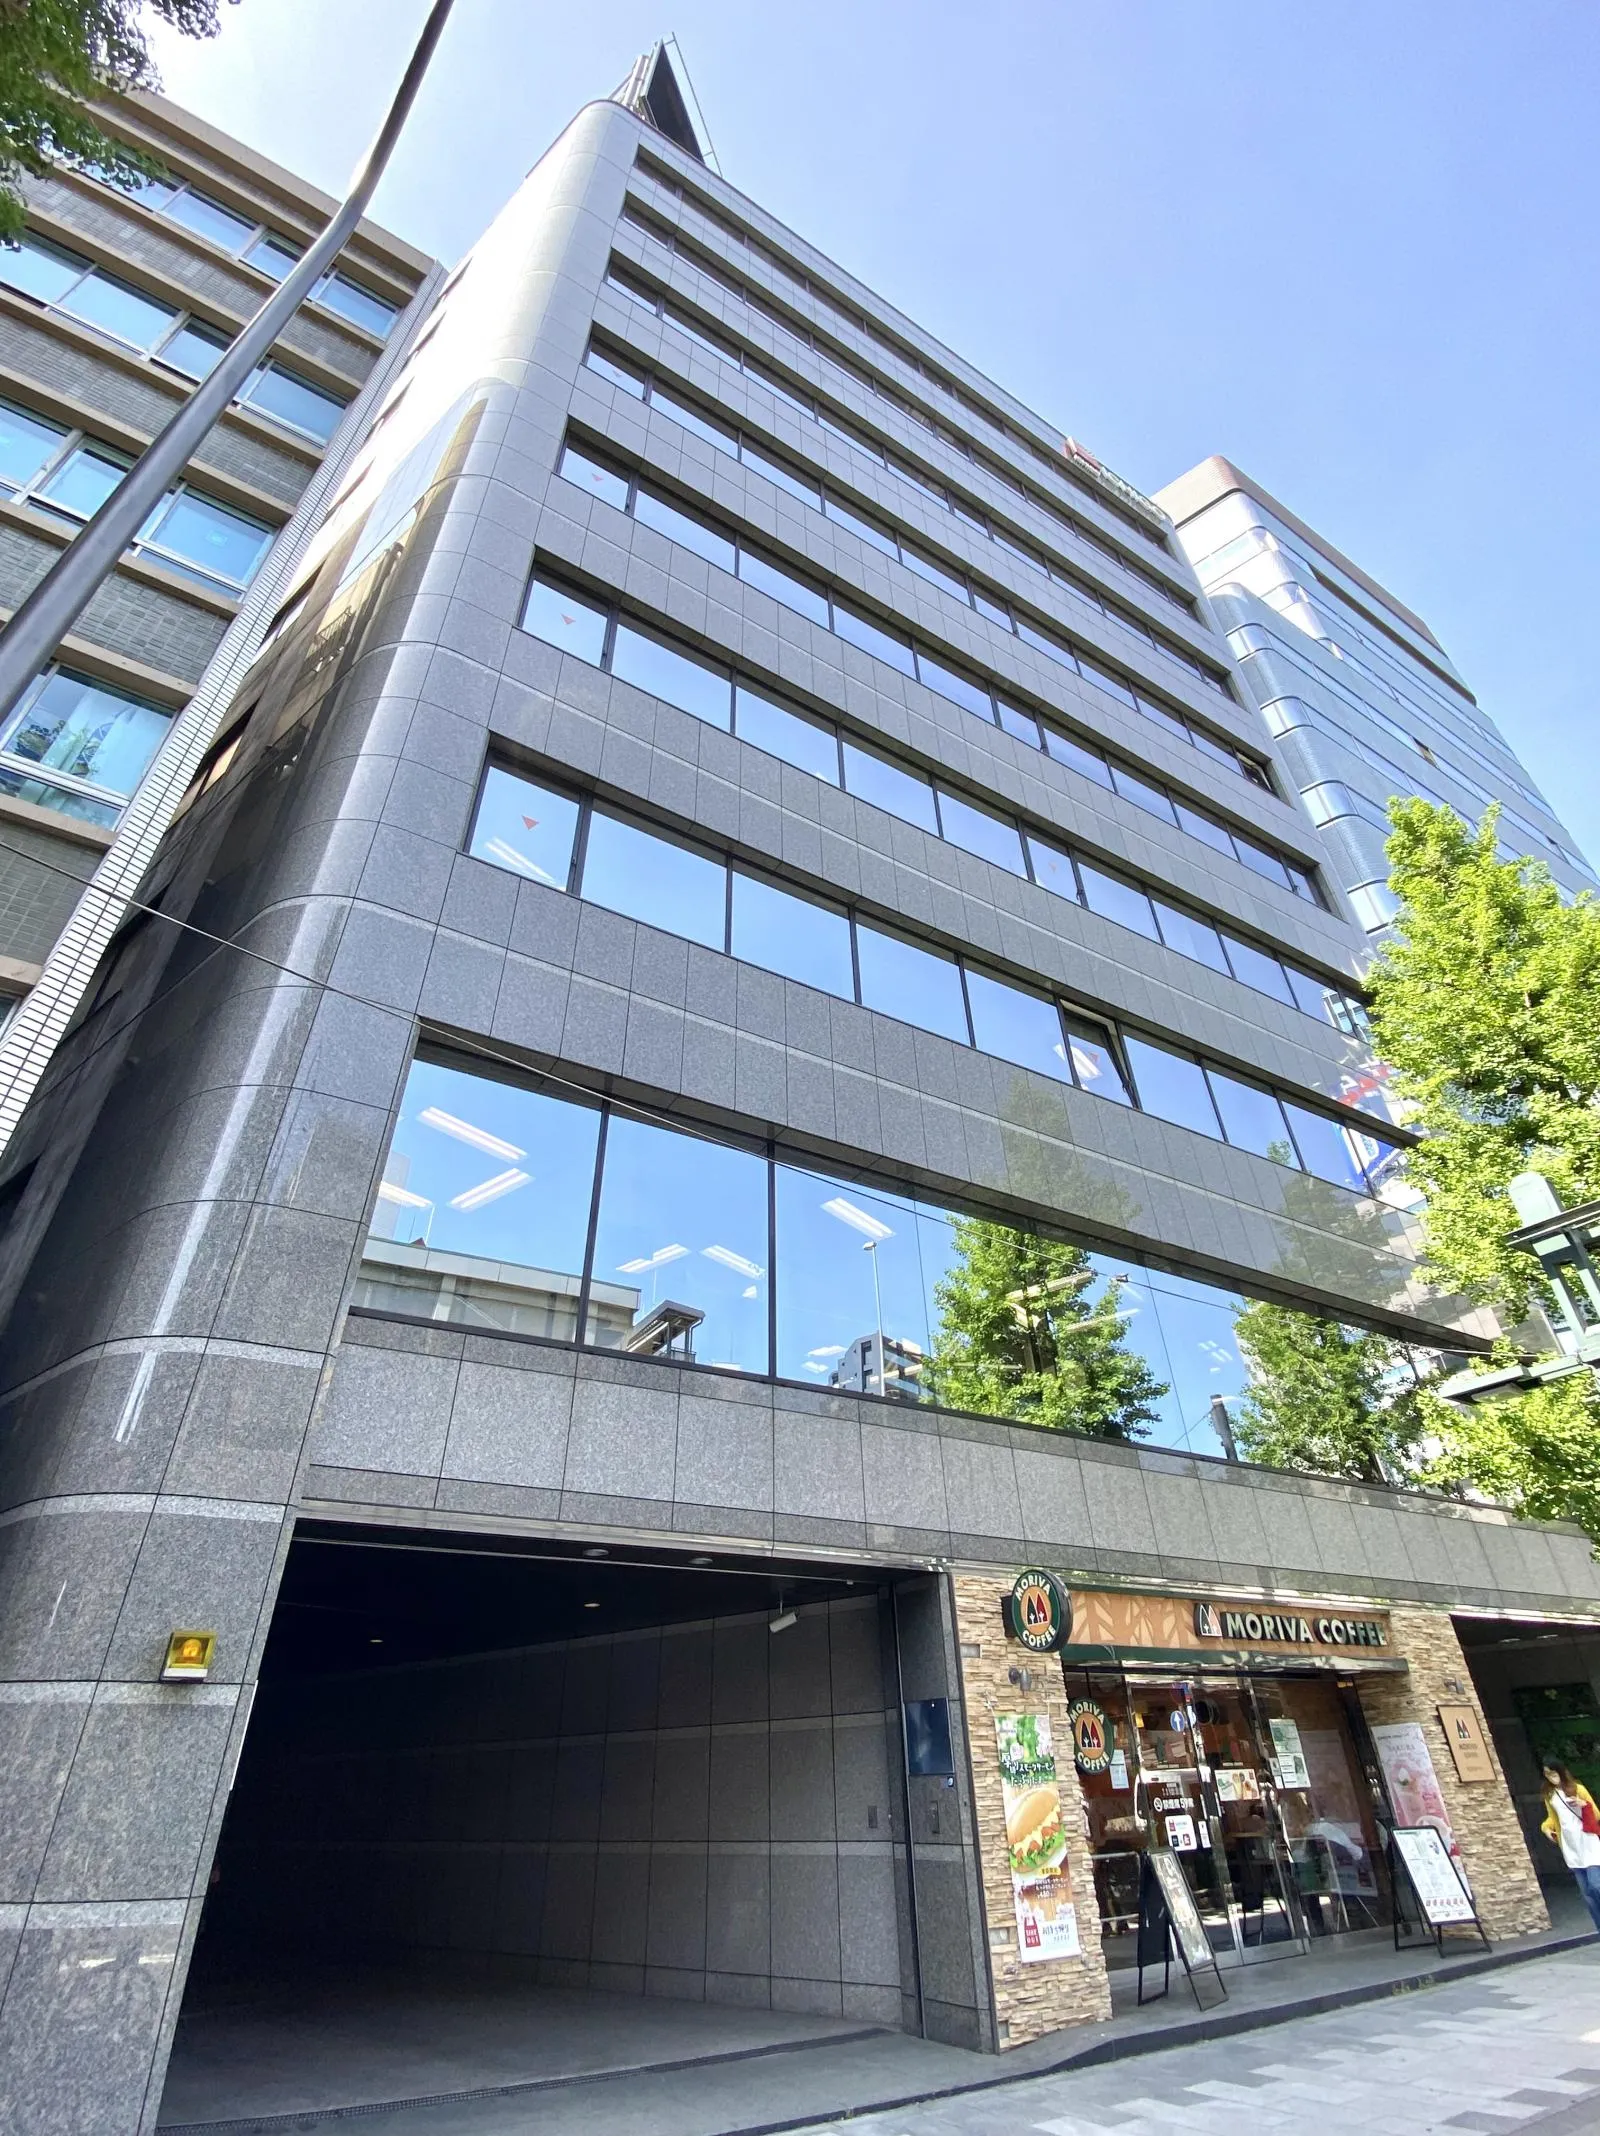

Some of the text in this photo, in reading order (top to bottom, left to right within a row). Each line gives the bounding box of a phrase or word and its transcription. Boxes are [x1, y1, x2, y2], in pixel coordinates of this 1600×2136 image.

[1015, 1575, 1051, 1601] MORIVA
[1022, 1624, 1057, 1648] COFFEE
[1222, 1612, 1388, 1647] MORIVA COFFEE
[1070, 1701, 1105, 1725] MORIVA
[1077, 1751, 1110, 1771] COFFEE
